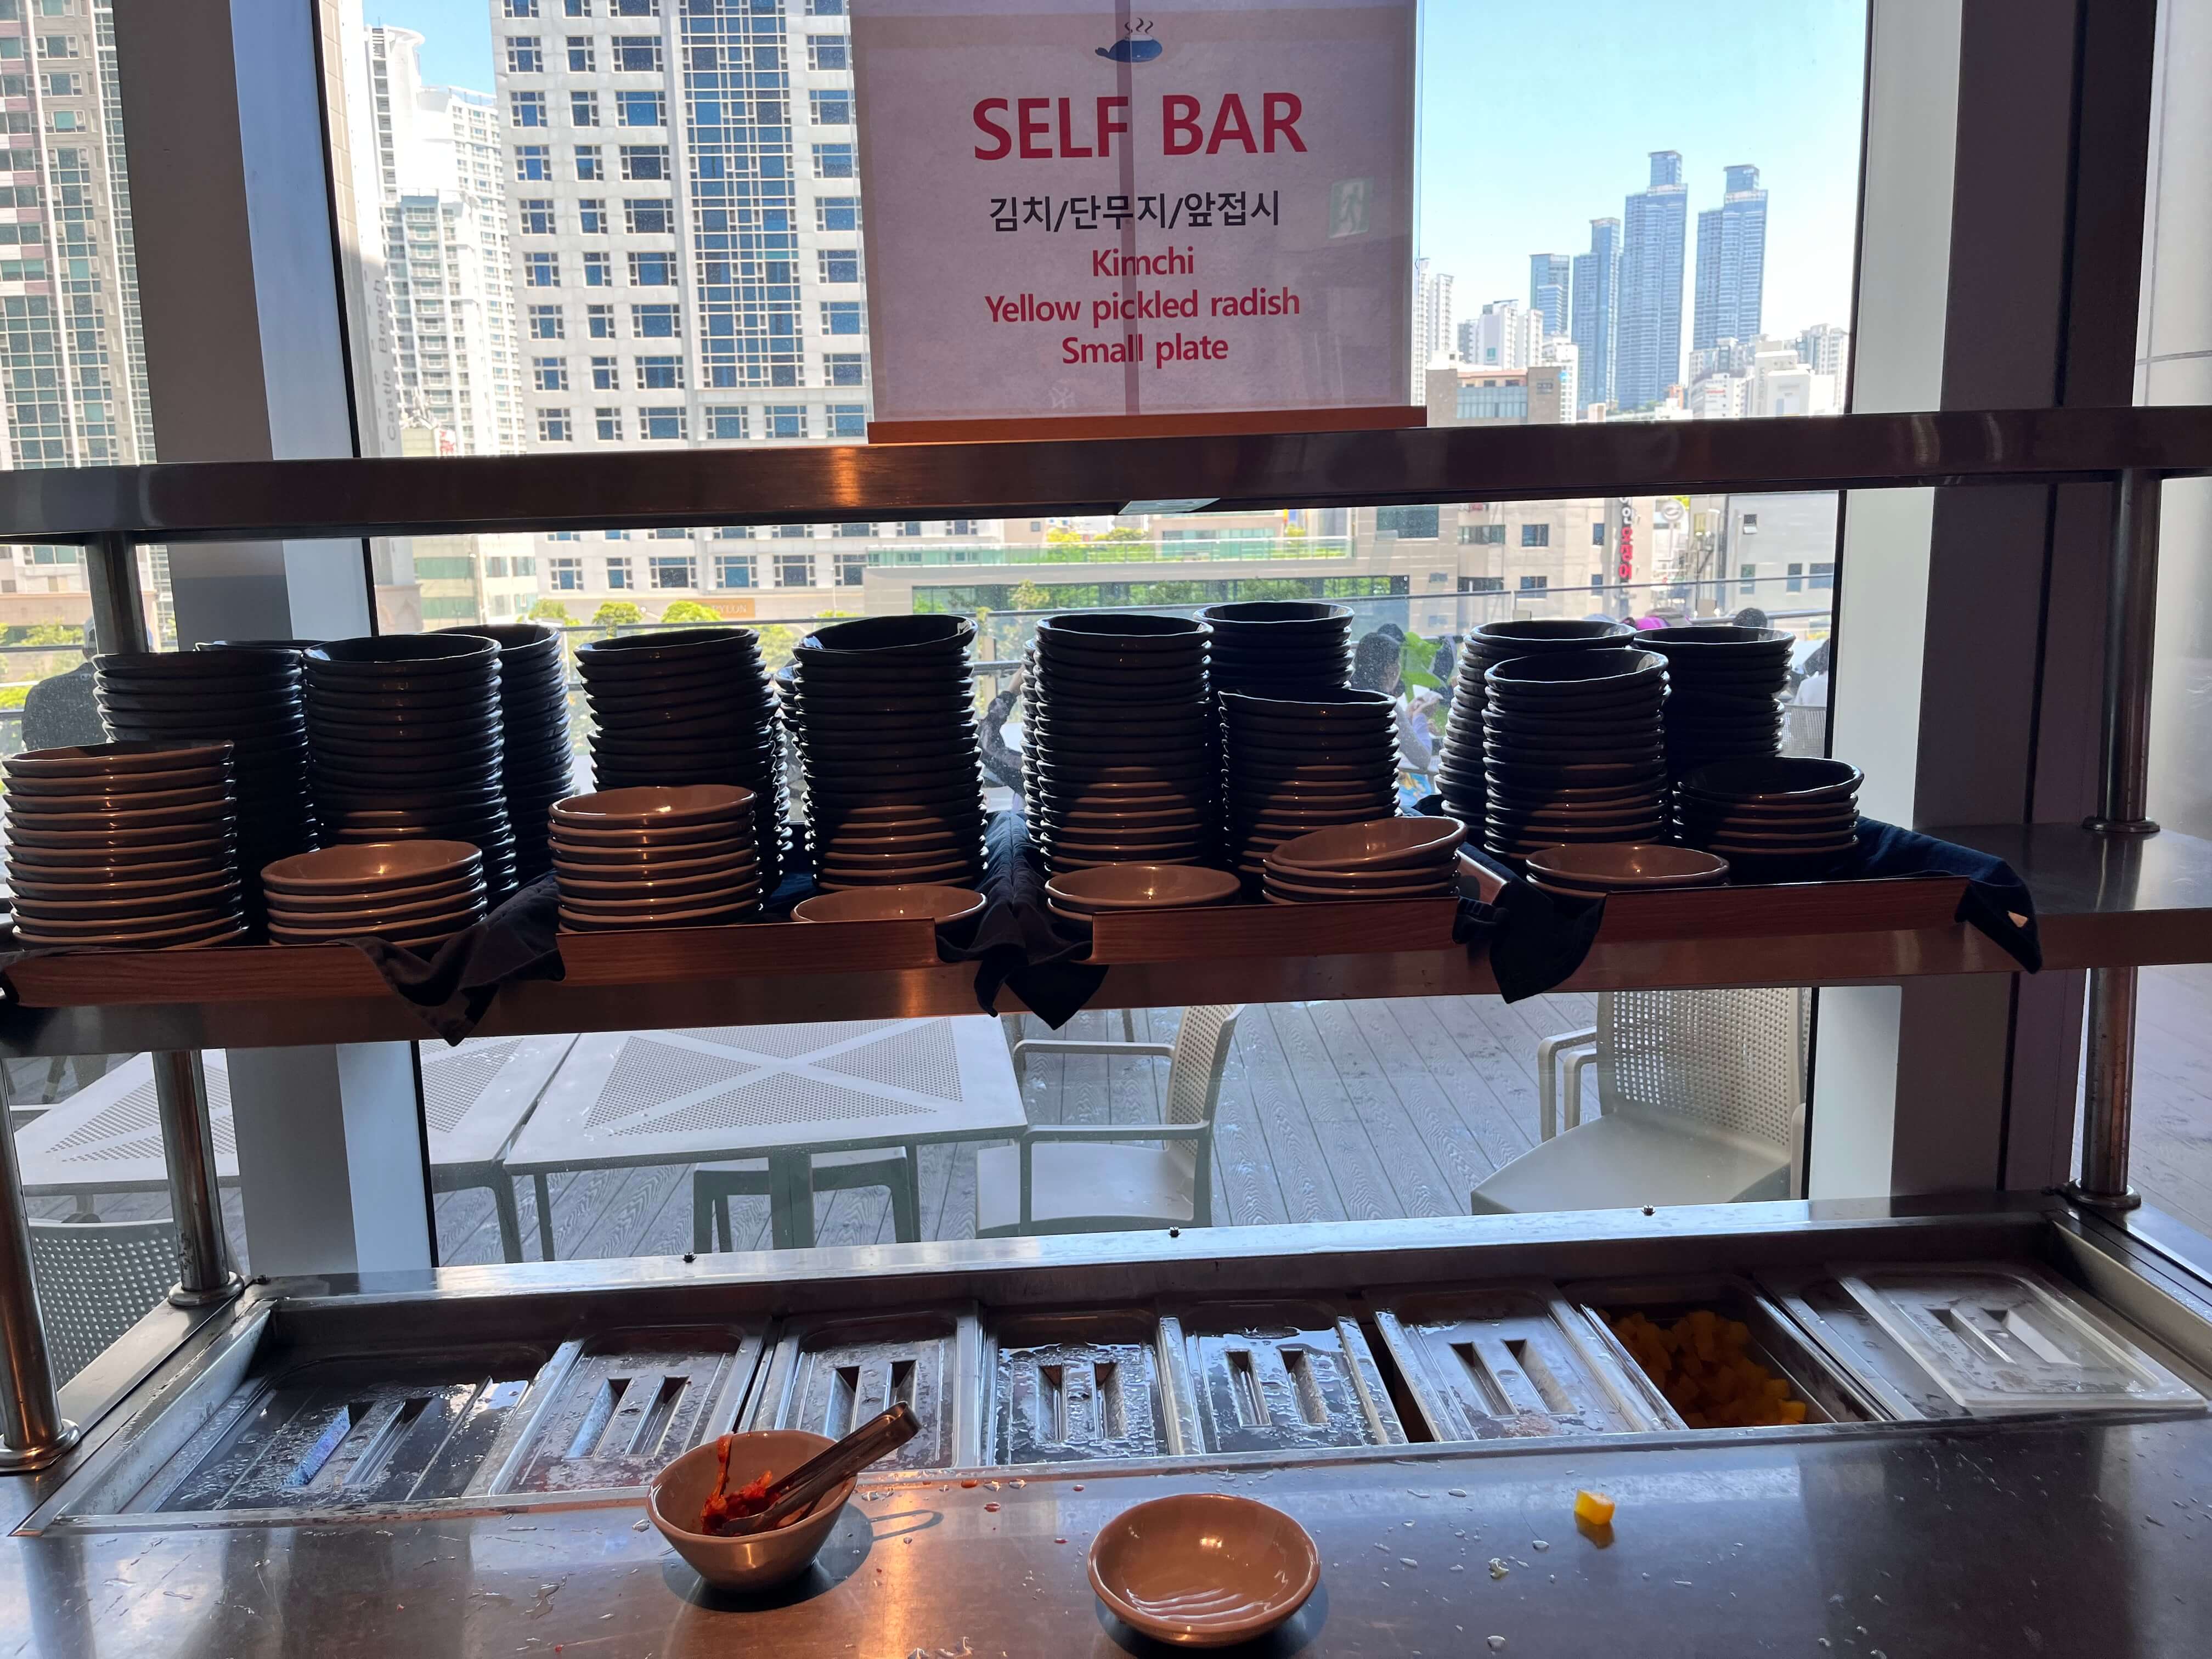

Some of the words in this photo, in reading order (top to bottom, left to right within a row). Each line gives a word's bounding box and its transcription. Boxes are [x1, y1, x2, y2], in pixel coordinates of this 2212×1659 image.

[973, 96, 1129, 160] SELF
[1162, 92, 1307, 155] BAR
[990, 190, 1280, 232] 김치/단무지/앞접시
[1092, 246, 1194, 276] Kimchi
[373, 279, 387, 353] Beach
[985, 294, 1080, 323] Yellow
[1092, 290, 1198, 328] pickled
[1211, 286, 1300, 317] radish
[1062, 333, 1143, 364] Small
[1155, 332, 1229, 369] plate
[382, 370, 396, 441] Castle
